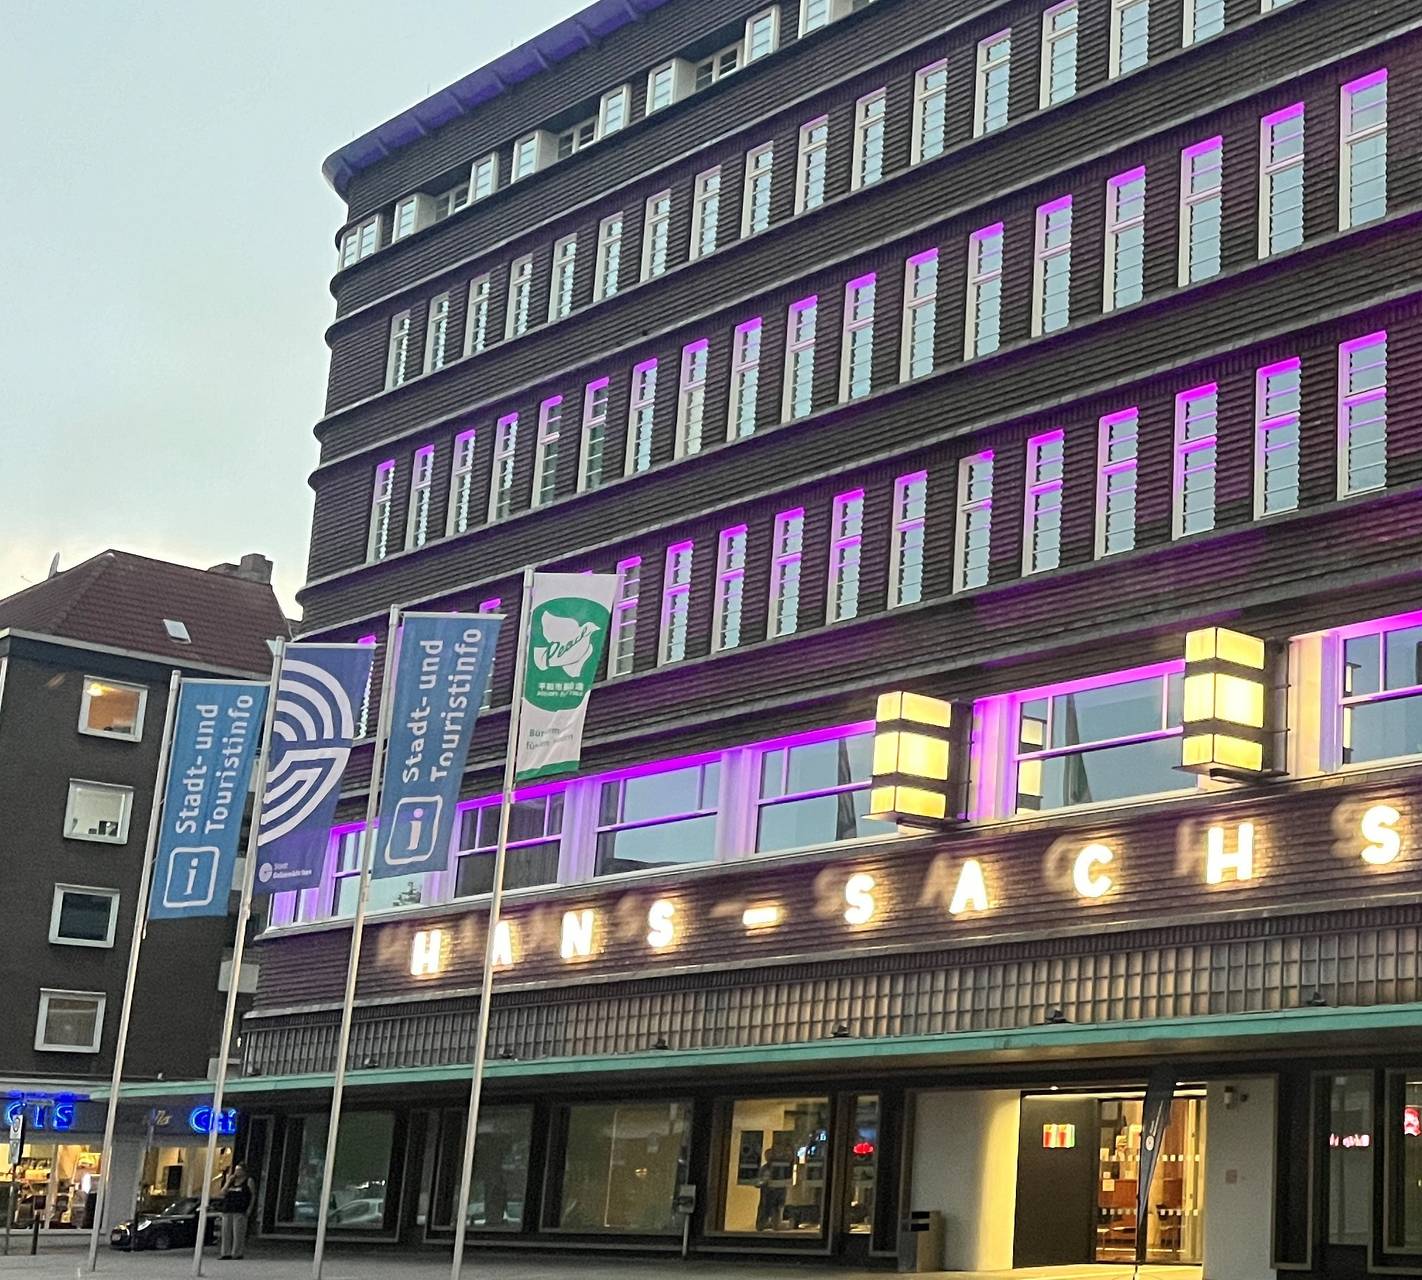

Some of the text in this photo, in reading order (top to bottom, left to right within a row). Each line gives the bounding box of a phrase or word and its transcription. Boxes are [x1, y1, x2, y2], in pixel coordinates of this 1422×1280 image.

[175, 703, 219, 834] Stadt- und
[204, 694, 254, 834] Touristinfo
[402, 639, 444, 785] Stadt- und
[430, 628, 482, 783] Touristinfo
